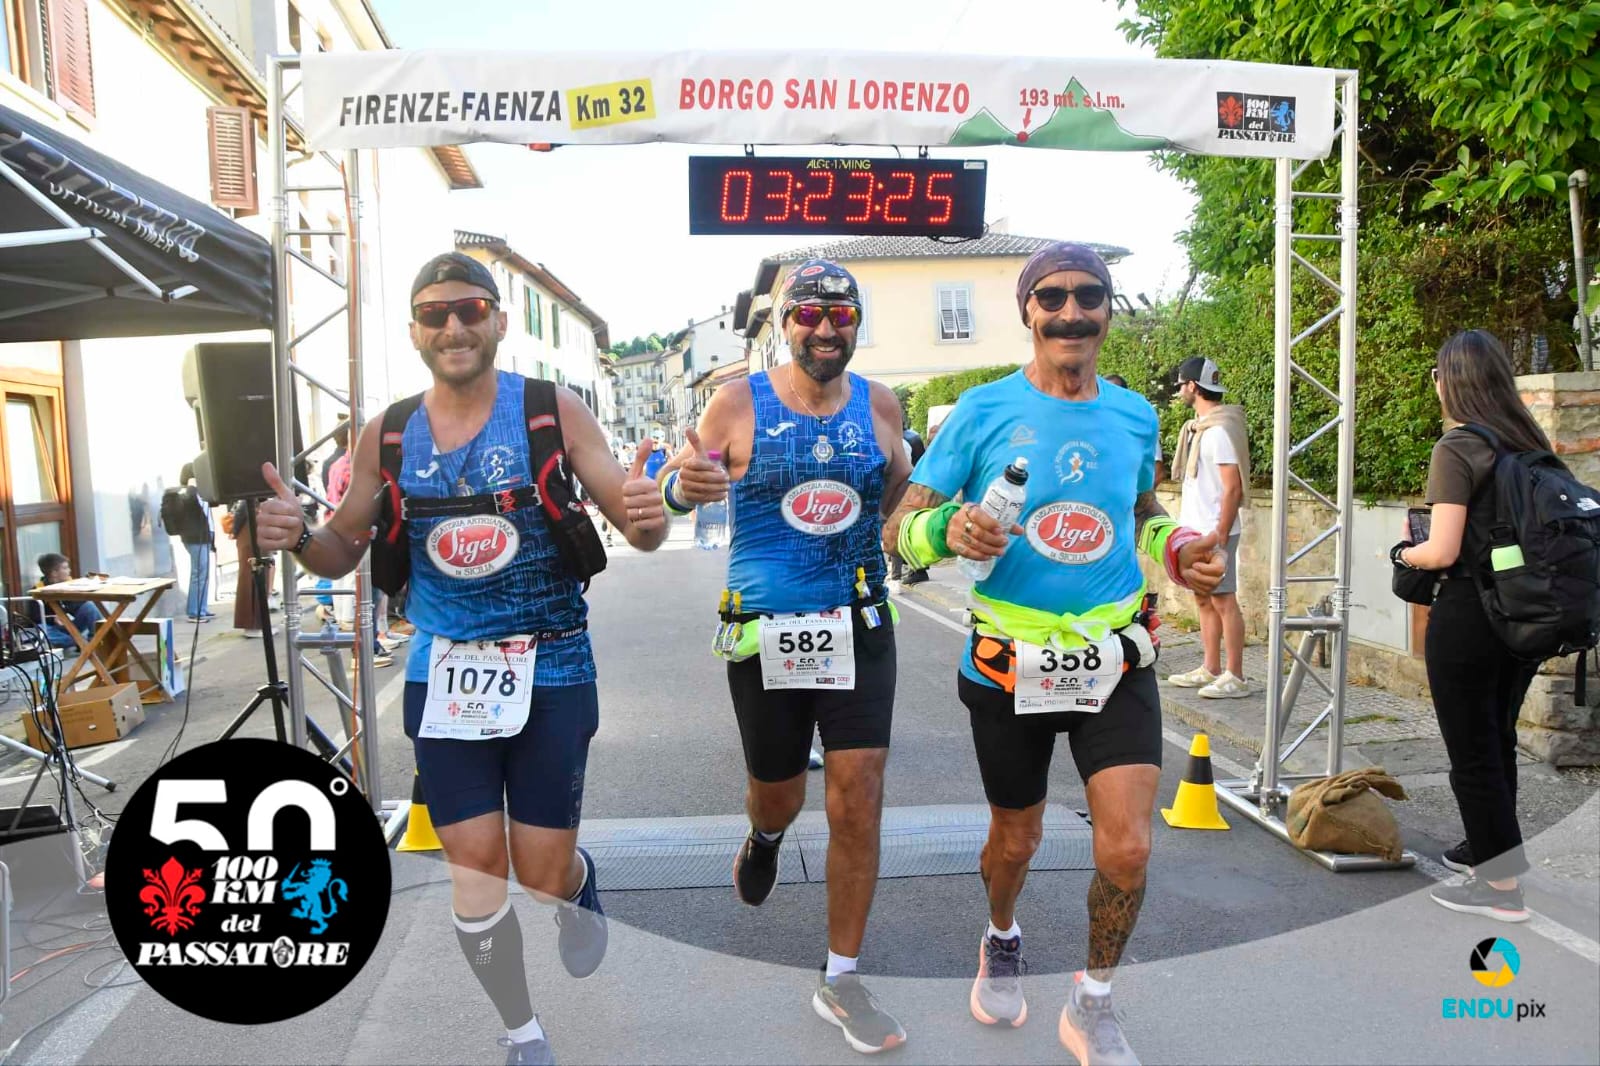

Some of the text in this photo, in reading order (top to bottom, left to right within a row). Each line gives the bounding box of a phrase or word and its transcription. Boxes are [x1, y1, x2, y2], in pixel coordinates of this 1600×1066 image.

[339, 90, 562, 127] FIRENZE-FAENZA
[576, 86, 646, 121] Km 32
[679, 77, 970, 114] BORGO SAN LORENZO
[1019, 88, 1125, 108] 193 mt. s.l.m.
[1217, 129, 1296, 143] PASSATORE
[1248, 120, 1264, 129] del
[794, 488, 849, 522] Sigel
[443, 525, 500, 564] Sigel
[1040, 511, 1102, 549] Sigel
[778, 629, 834, 654] 582
[1039, 644, 1101, 673] 358
[446, 667, 516, 697] 1078
